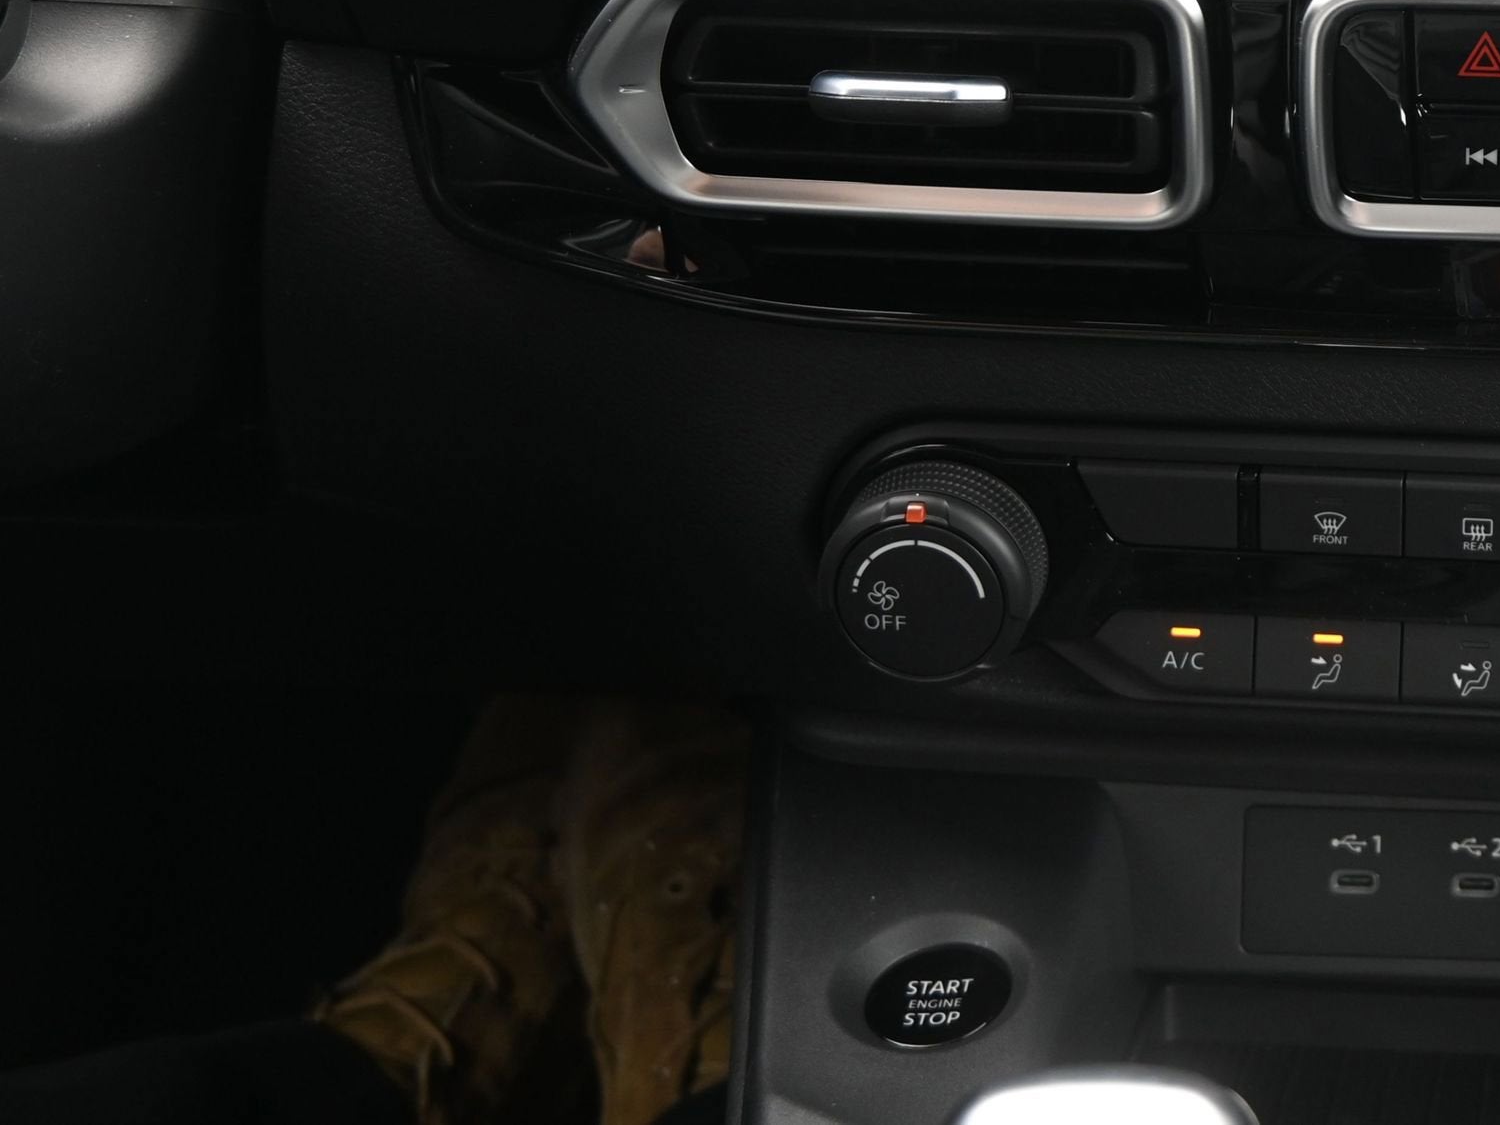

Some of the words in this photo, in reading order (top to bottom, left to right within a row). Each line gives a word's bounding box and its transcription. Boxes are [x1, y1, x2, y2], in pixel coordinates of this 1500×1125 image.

[1312, 535, 1348, 545] FRONT
[1463, 542, 1493, 551] REAR
[865, 614, 906, 631] OFF
[1163, 651, 1203, 670] A/C
[1373, 835, 1381, 853] 1
[907, 979, 973, 995] START
[909, 998, 961, 1008] ENGINE
[904, 1011, 960, 1025] STOP
